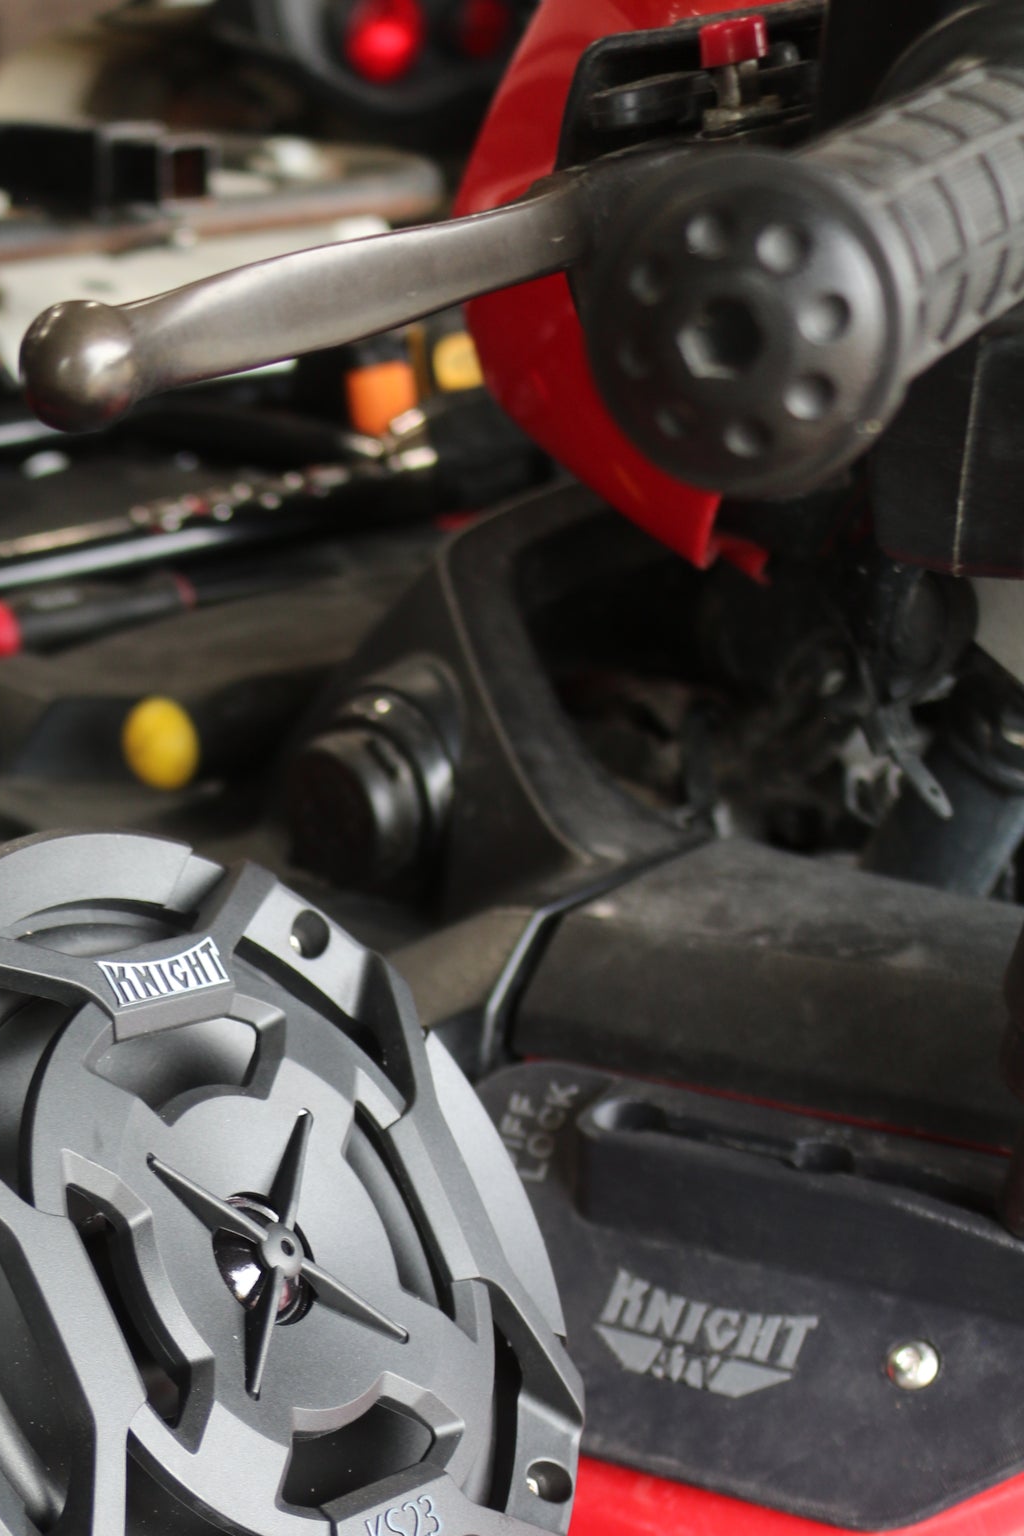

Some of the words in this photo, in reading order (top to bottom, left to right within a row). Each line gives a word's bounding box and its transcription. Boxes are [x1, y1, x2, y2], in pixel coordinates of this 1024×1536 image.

[102, 939, 228, 1004] KNIGHT
[500, 1090, 535, 1166] IFF
[517, 1079, 579, 1183] LOCK
[600, 1268, 819, 1369] KNIGHT
